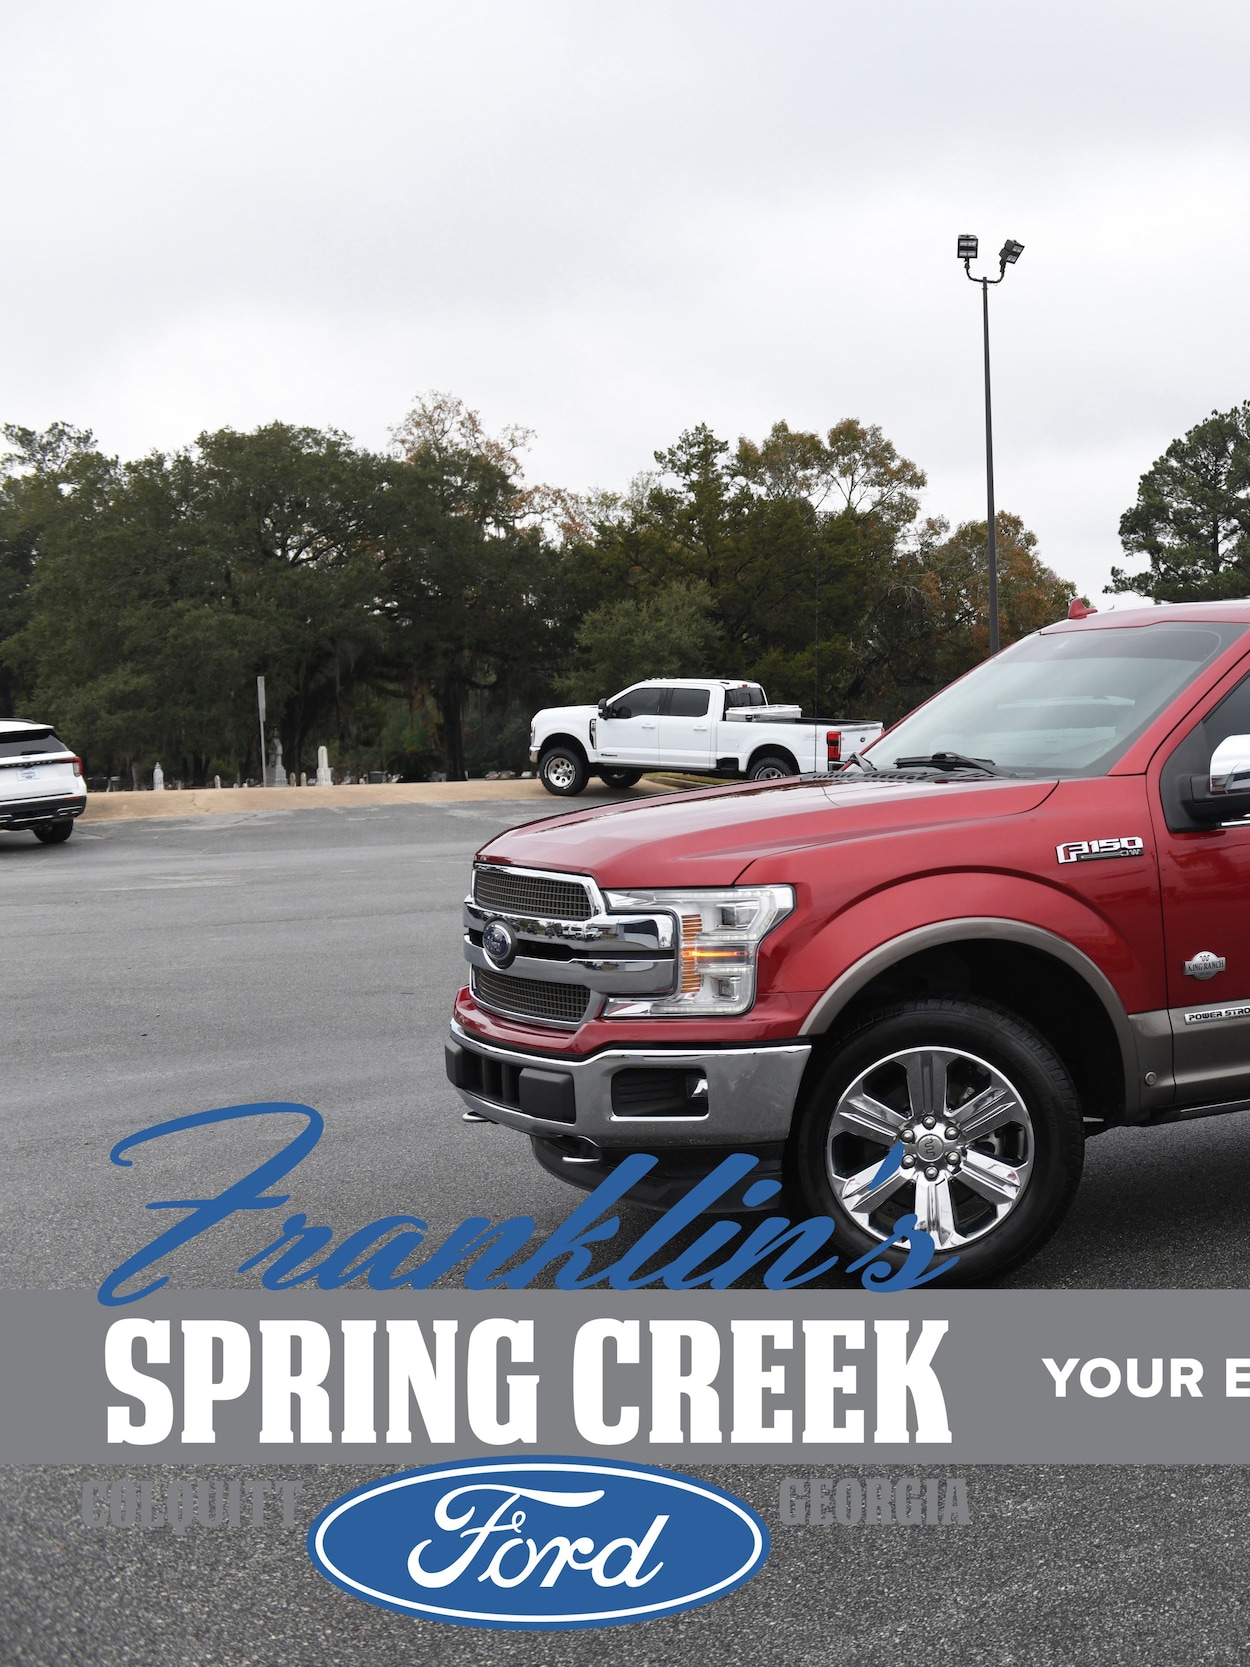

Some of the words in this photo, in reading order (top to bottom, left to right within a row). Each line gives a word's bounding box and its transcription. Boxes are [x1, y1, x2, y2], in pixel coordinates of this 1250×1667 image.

[1188, 963, 1203, 972] KING
[1204, 960, 1224, 970] RANCH
[1189, 1012, 1222, 1021] POWER
